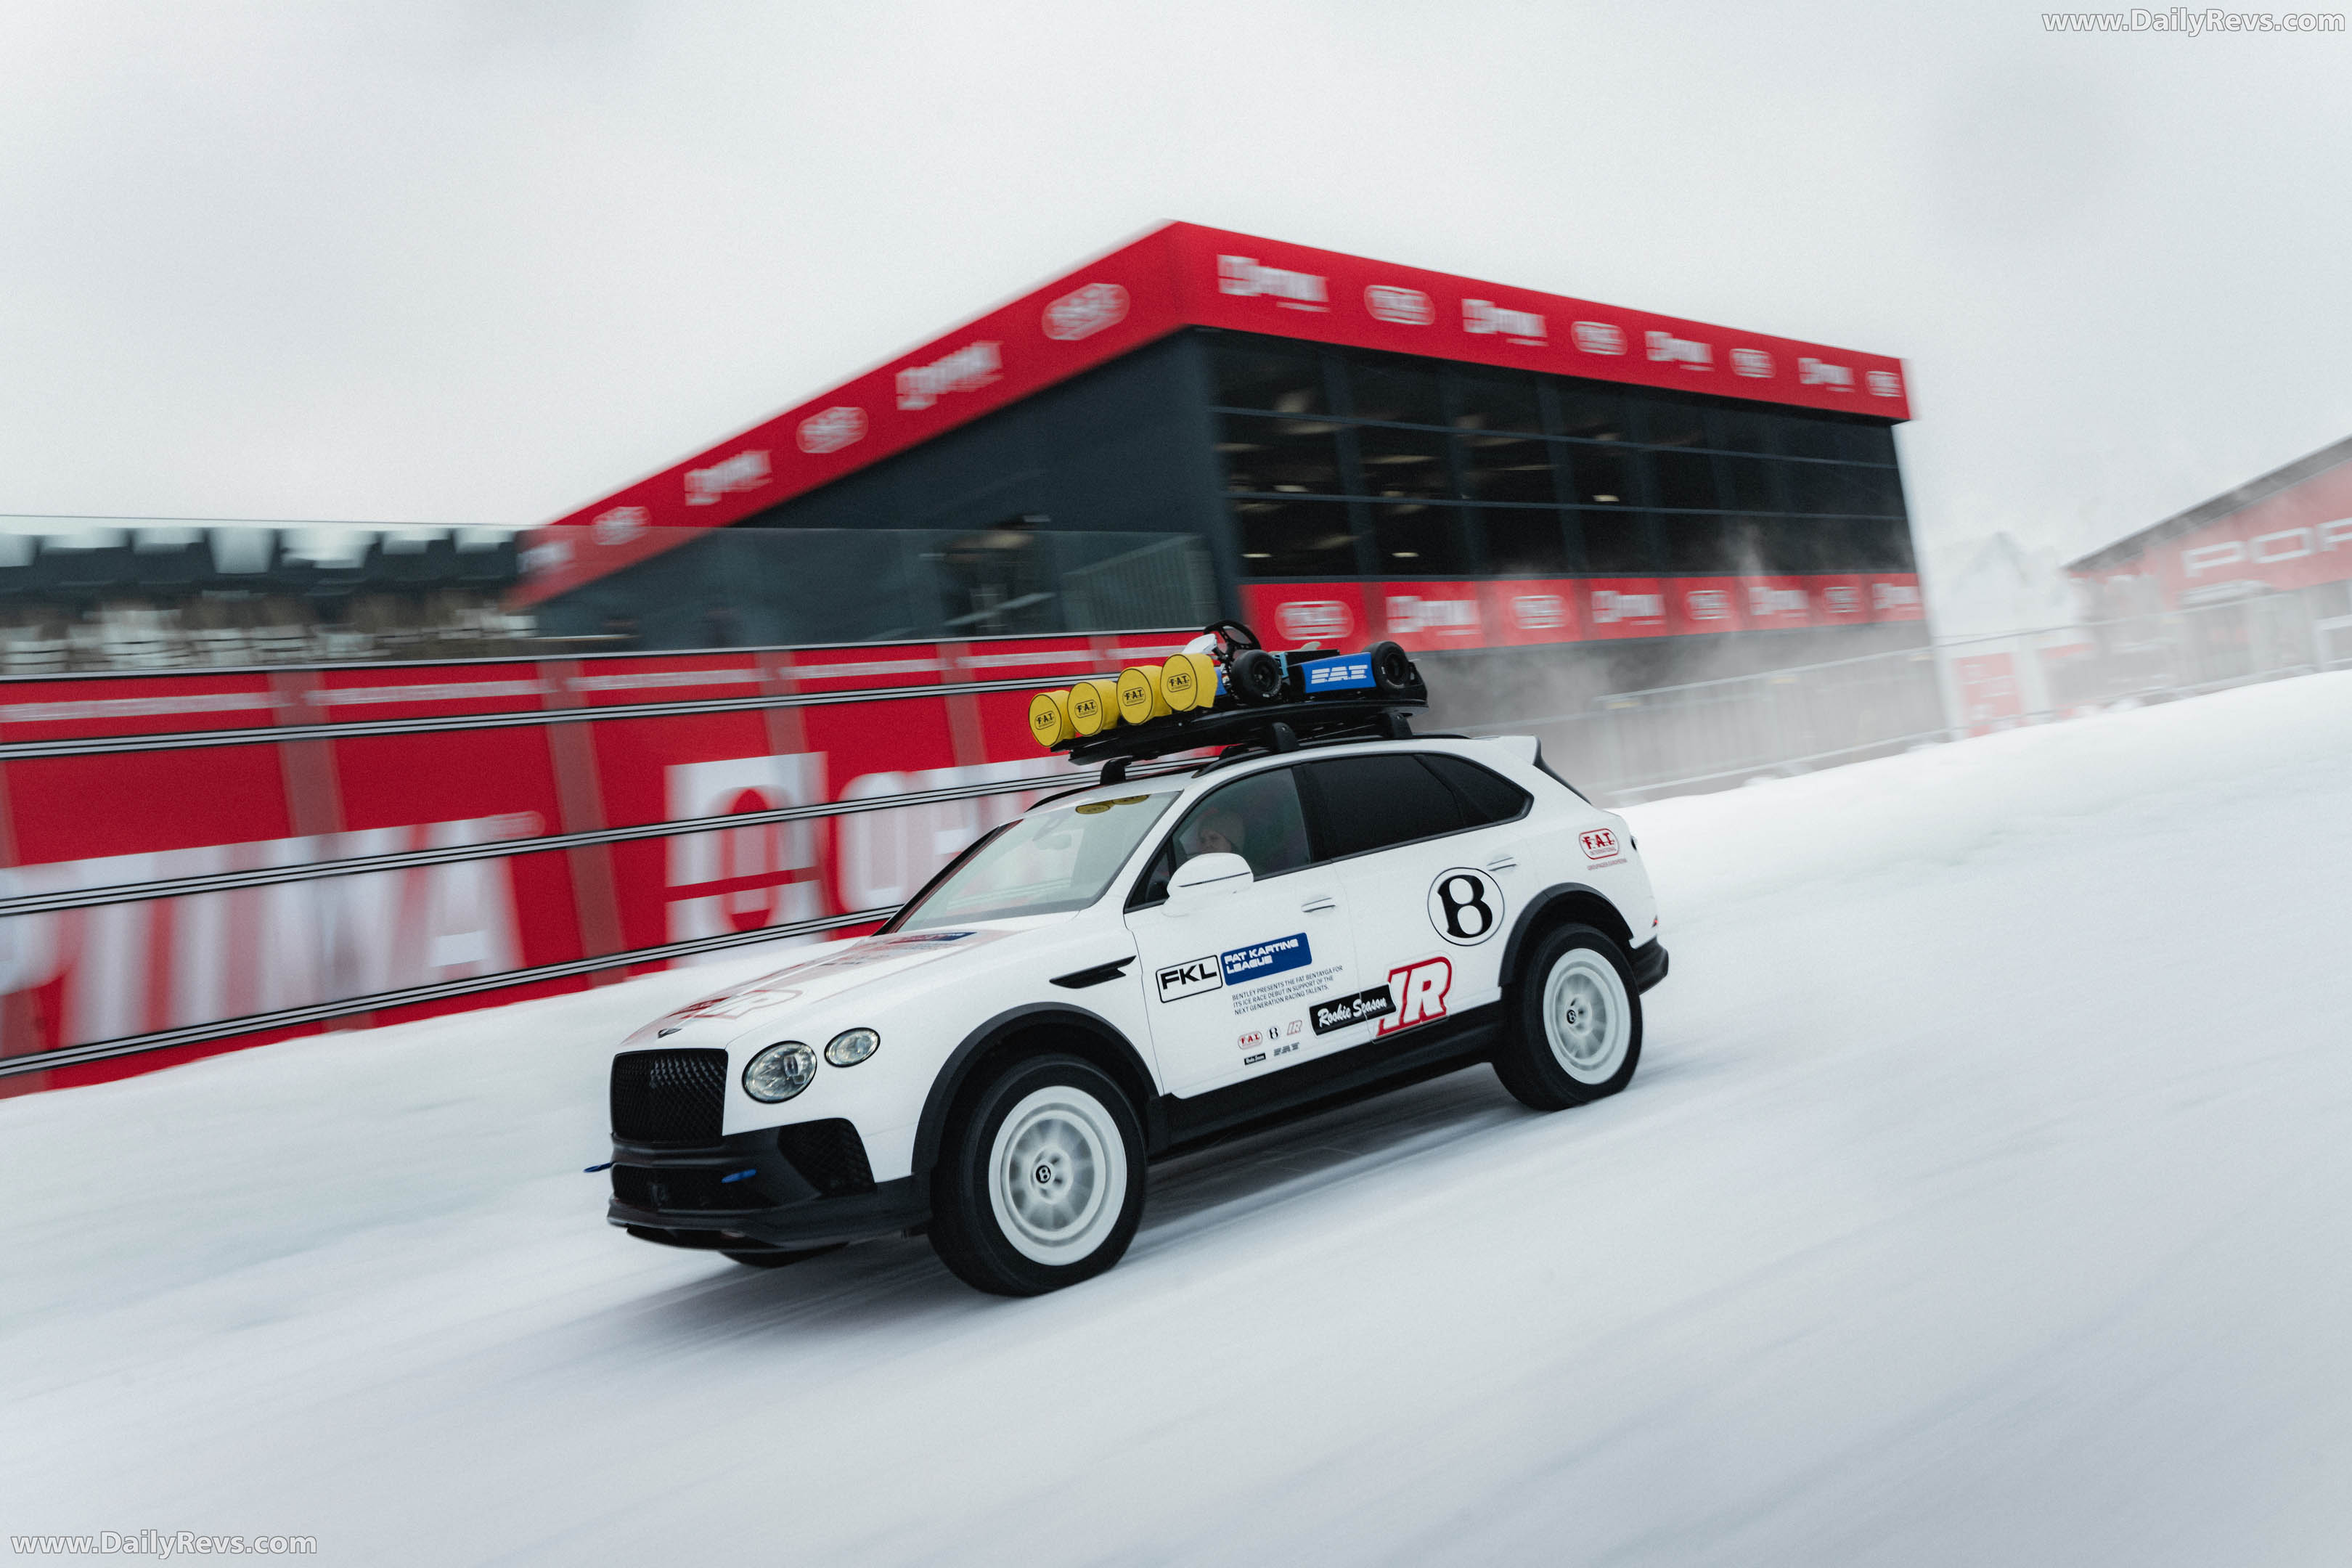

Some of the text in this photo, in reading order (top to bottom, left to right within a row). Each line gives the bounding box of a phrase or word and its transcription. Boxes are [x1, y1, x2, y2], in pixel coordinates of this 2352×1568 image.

[1224, 939, 1299, 965] FAT KARTING
[1226, 955, 1273, 974] LEAGUE
[1160, 963, 1217, 990] FKL
[1232, 989, 1257, 1001] BENTLEY
[1257, 981, 1285, 994] PRESENTS
[1285, 979, 1296, 987] THE
[1306, 968, 1332, 981] BENTAYGA
[1233, 1000, 1242, 1008] ITS
[1243, 997, 1252, 1006] ICE
[1252, 994, 1267, 1003] RACE
[1268, 989, 1286, 1000] DEBUT
[1292, 980, 1315, 992] SUPPORT
[1234, 1007, 1249, 1016] NEXT
[1250, 997, 1284, 1012] GENERATION
[1284, 990, 1305, 1002] RACING
[1317, 996, 1388, 1028] Rookie Season
